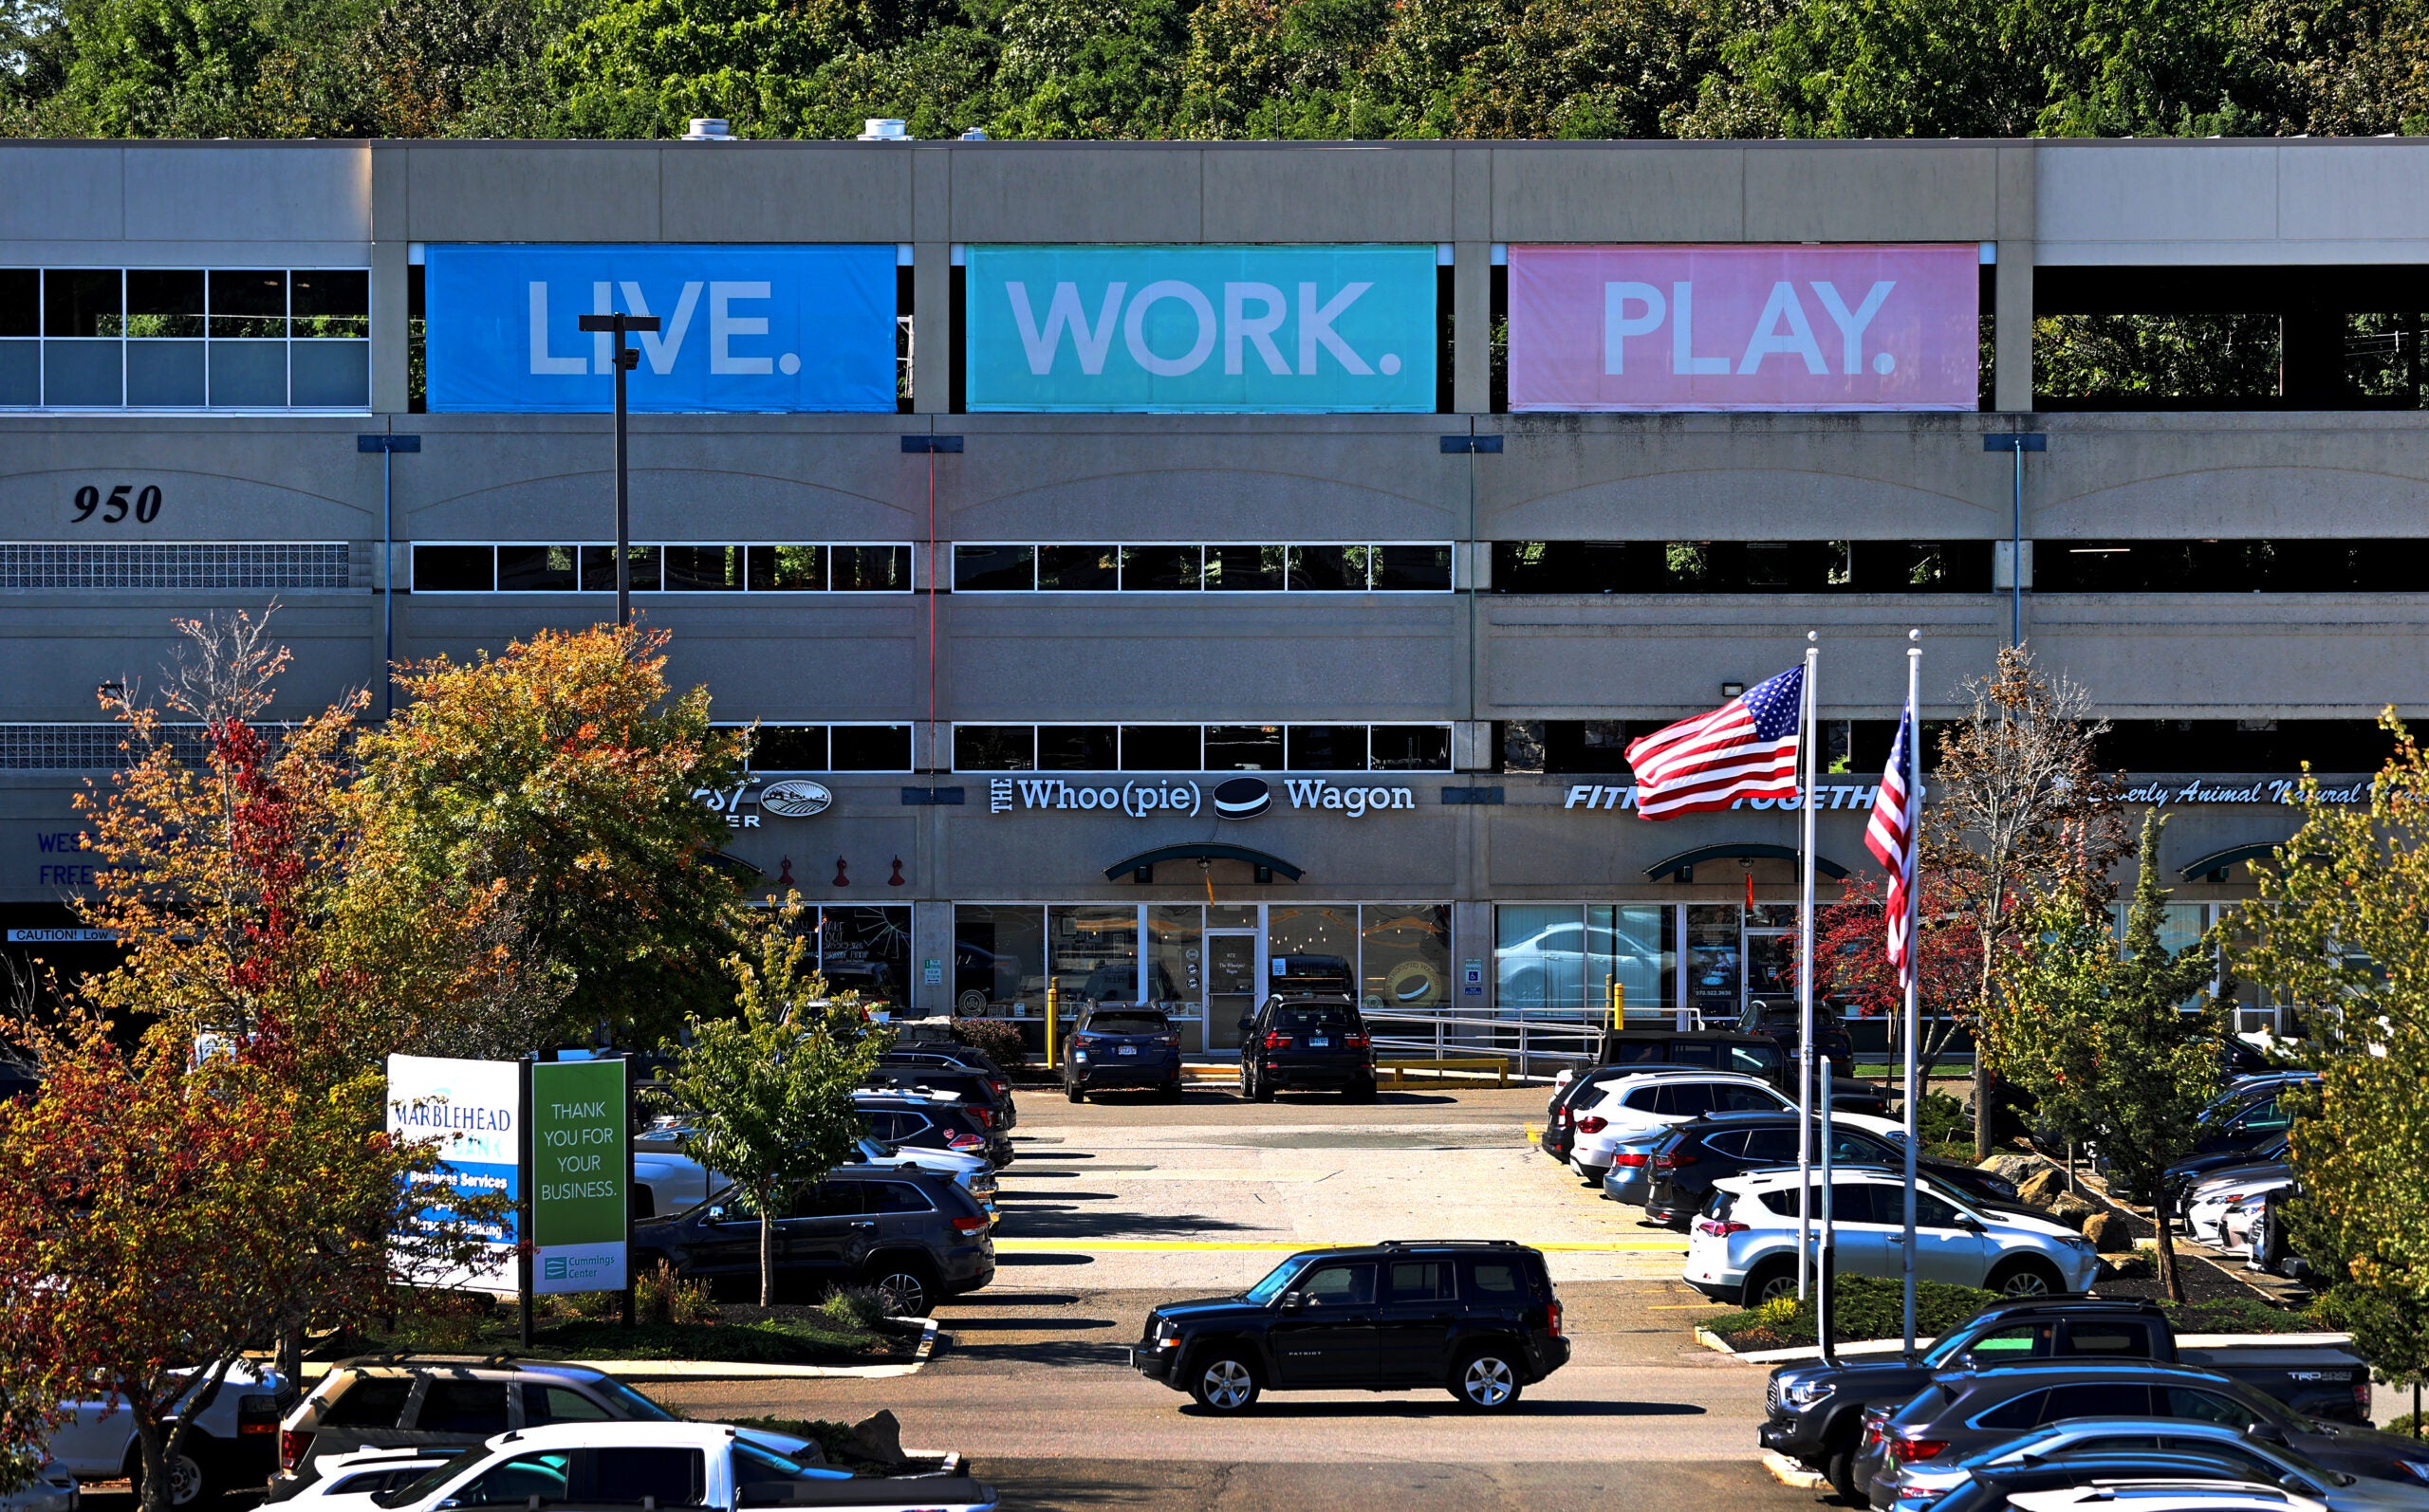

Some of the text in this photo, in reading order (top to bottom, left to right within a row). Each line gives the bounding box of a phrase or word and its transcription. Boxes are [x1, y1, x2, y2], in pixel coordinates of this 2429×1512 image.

[529, 281, 801, 375] LIVE.
[1005, 280, 1401, 377] WORK.
[1604, 281, 1897, 375] PLAY.
[70, 485, 162, 523] 950
[991, 778, 1012, 814] THE
[1017, 779, 1415, 818] Whoo(pie) Wagon
[2174, 779, 2261, 803] Animal
[2269, 779, 2363, 804] Naural
[40, 865, 93, 885] FREE
[16, 930, 77, 942] CAUTION!
[83, 930, 109, 941] Low
[395, 1106, 511, 1132] MARBLEHEAD
[551, 1101, 606, 1120] THANK
[544, 1128, 614, 1147] YOU FOR
[557, 1155, 601, 1172] YOUR
[409, 1171, 508, 1189] Business Services
[542, 1181, 618, 1201] BUSINESS.
[569, 1255, 615, 1267] Cummings
[569, 1268, 598, 1279] Center
